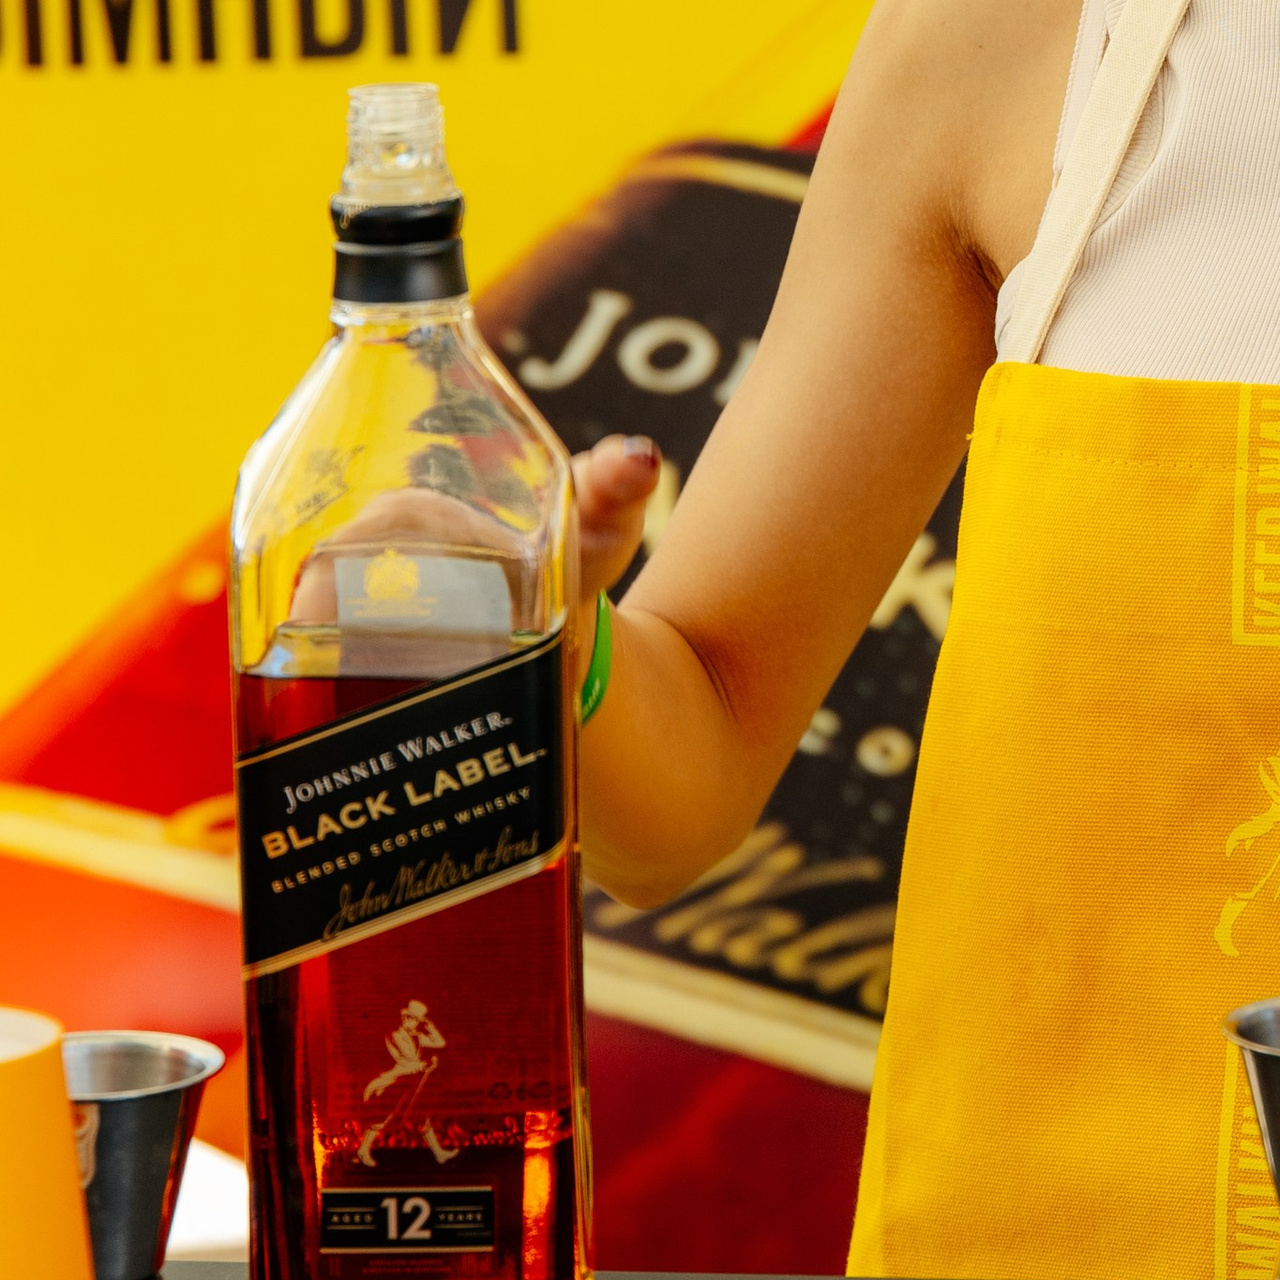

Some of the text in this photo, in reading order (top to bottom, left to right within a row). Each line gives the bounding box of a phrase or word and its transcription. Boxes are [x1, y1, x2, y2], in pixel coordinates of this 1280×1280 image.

[283, 751, 397, 814] JOHNNIE
[261, 789, 397, 859] BLACK
[271, 785, 532, 894] BLENDED SCOTCH WHISKY
[380, 1195, 432, 1241] 12
